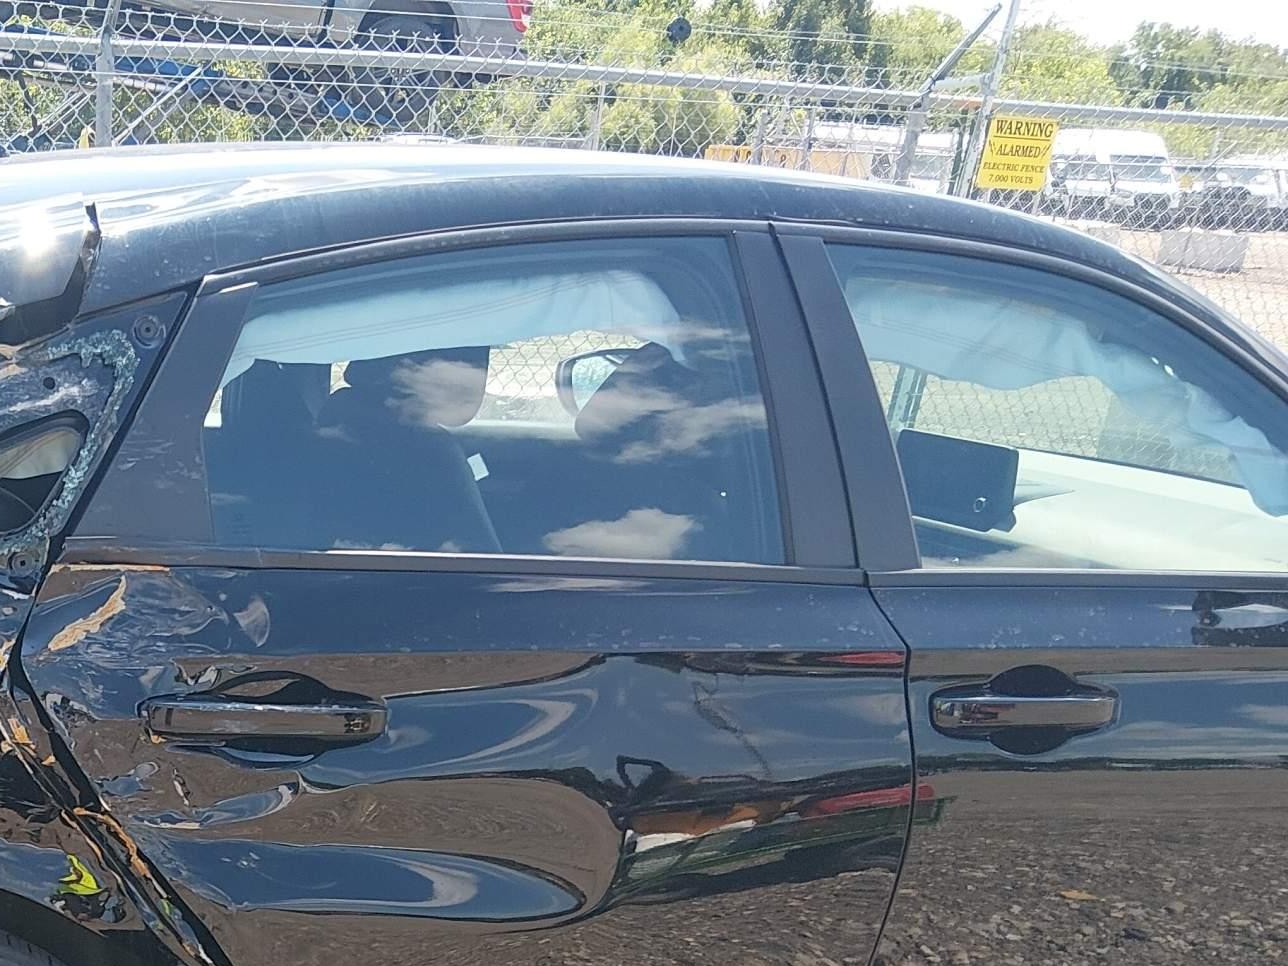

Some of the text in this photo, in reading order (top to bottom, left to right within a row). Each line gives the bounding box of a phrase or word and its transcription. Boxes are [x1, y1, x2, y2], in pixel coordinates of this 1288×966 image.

[995, 119, 1054, 138] WARNING
[996, 143, 1041, 158] ALARMED
[982, 161, 1045, 174] ELECTRIC FENCE
[1010, 175, 1034, 184] VOLTS
